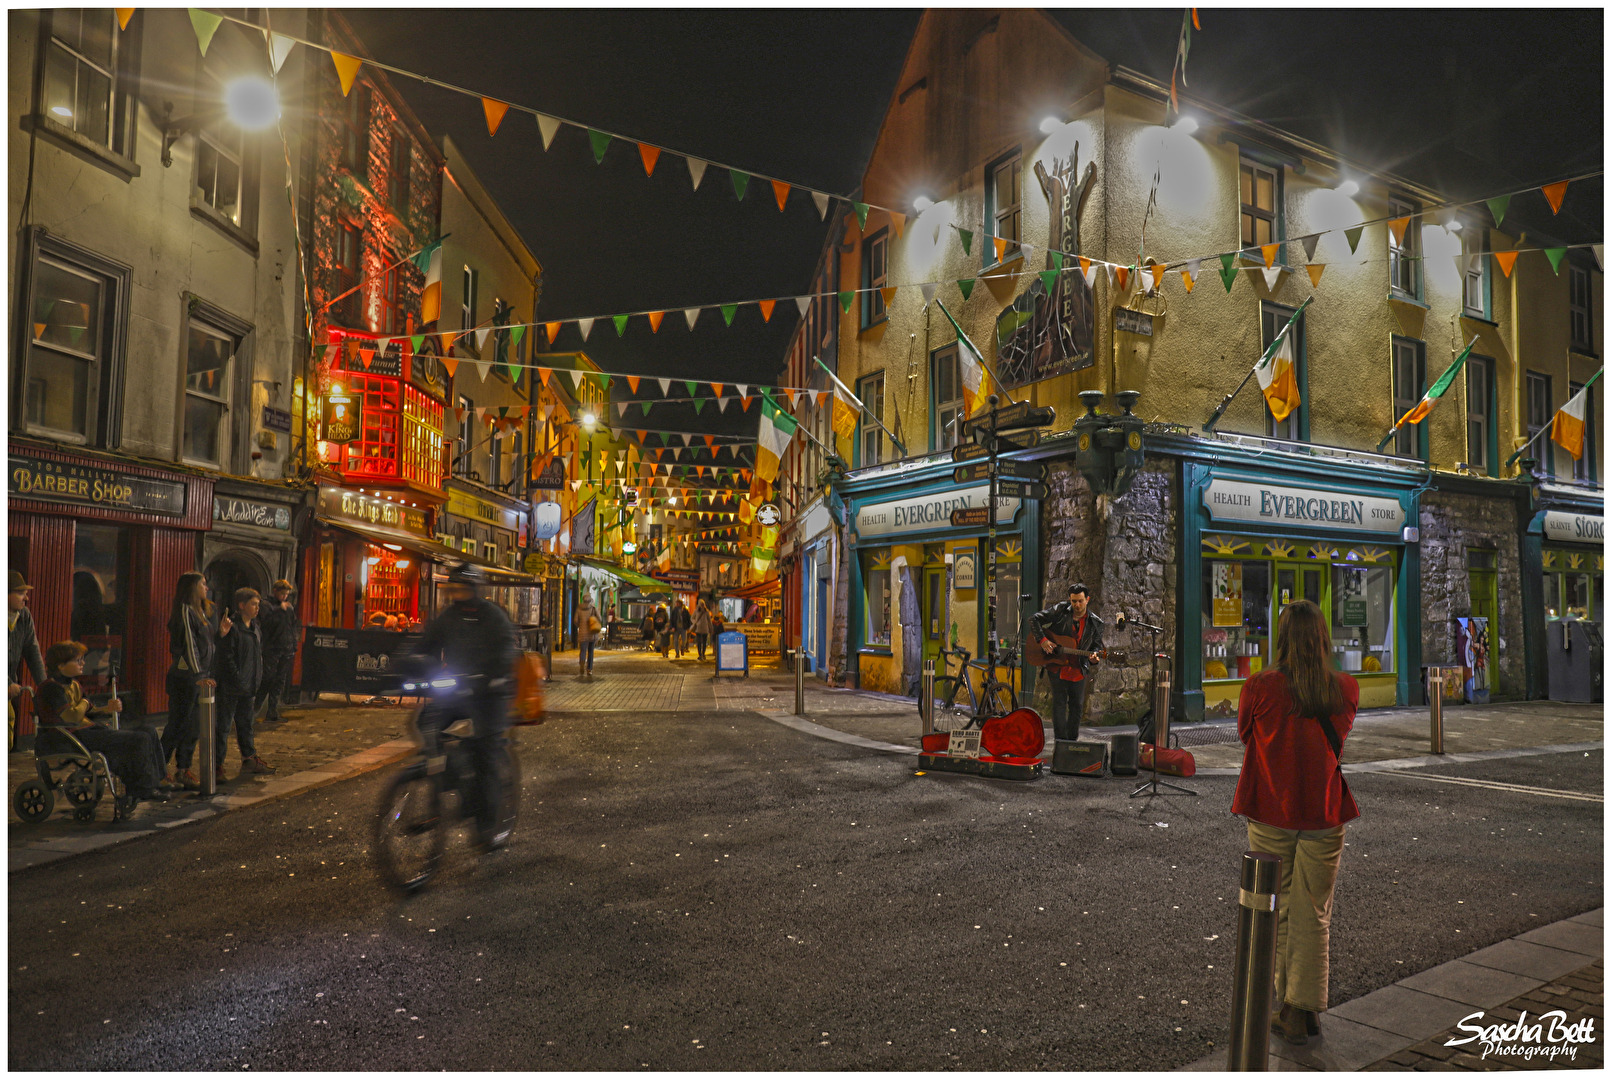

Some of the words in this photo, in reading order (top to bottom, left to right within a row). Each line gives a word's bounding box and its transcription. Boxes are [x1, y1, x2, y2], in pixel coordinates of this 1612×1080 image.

[1061, 158, 1074, 340] VERGREEN
[37, 462, 62, 473] TOM
[13, 467, 89, 496] BARBER
[92, 479, 132, 502] SHOP
[221, 500, 267, 522] Aladdin's
[255, 514, 274, 527] Cave
[342, 495, 356, 514] The
[358, 499, 380, 523] Kings
[381, 505, 399, 524] Head
[862, 513, 887, 526] HEALTH
[894, 495, 972, 527] EVERGREEN
[981, 497, 1010, 510] SORE
[1213, 492, 1250, 506] HEALTH
[1259, 489, 1364, 525] EVERGREEN
[1371, 508, 1395, 520] STORE
[1550, 519, 1571, 531] SLÁINTE
